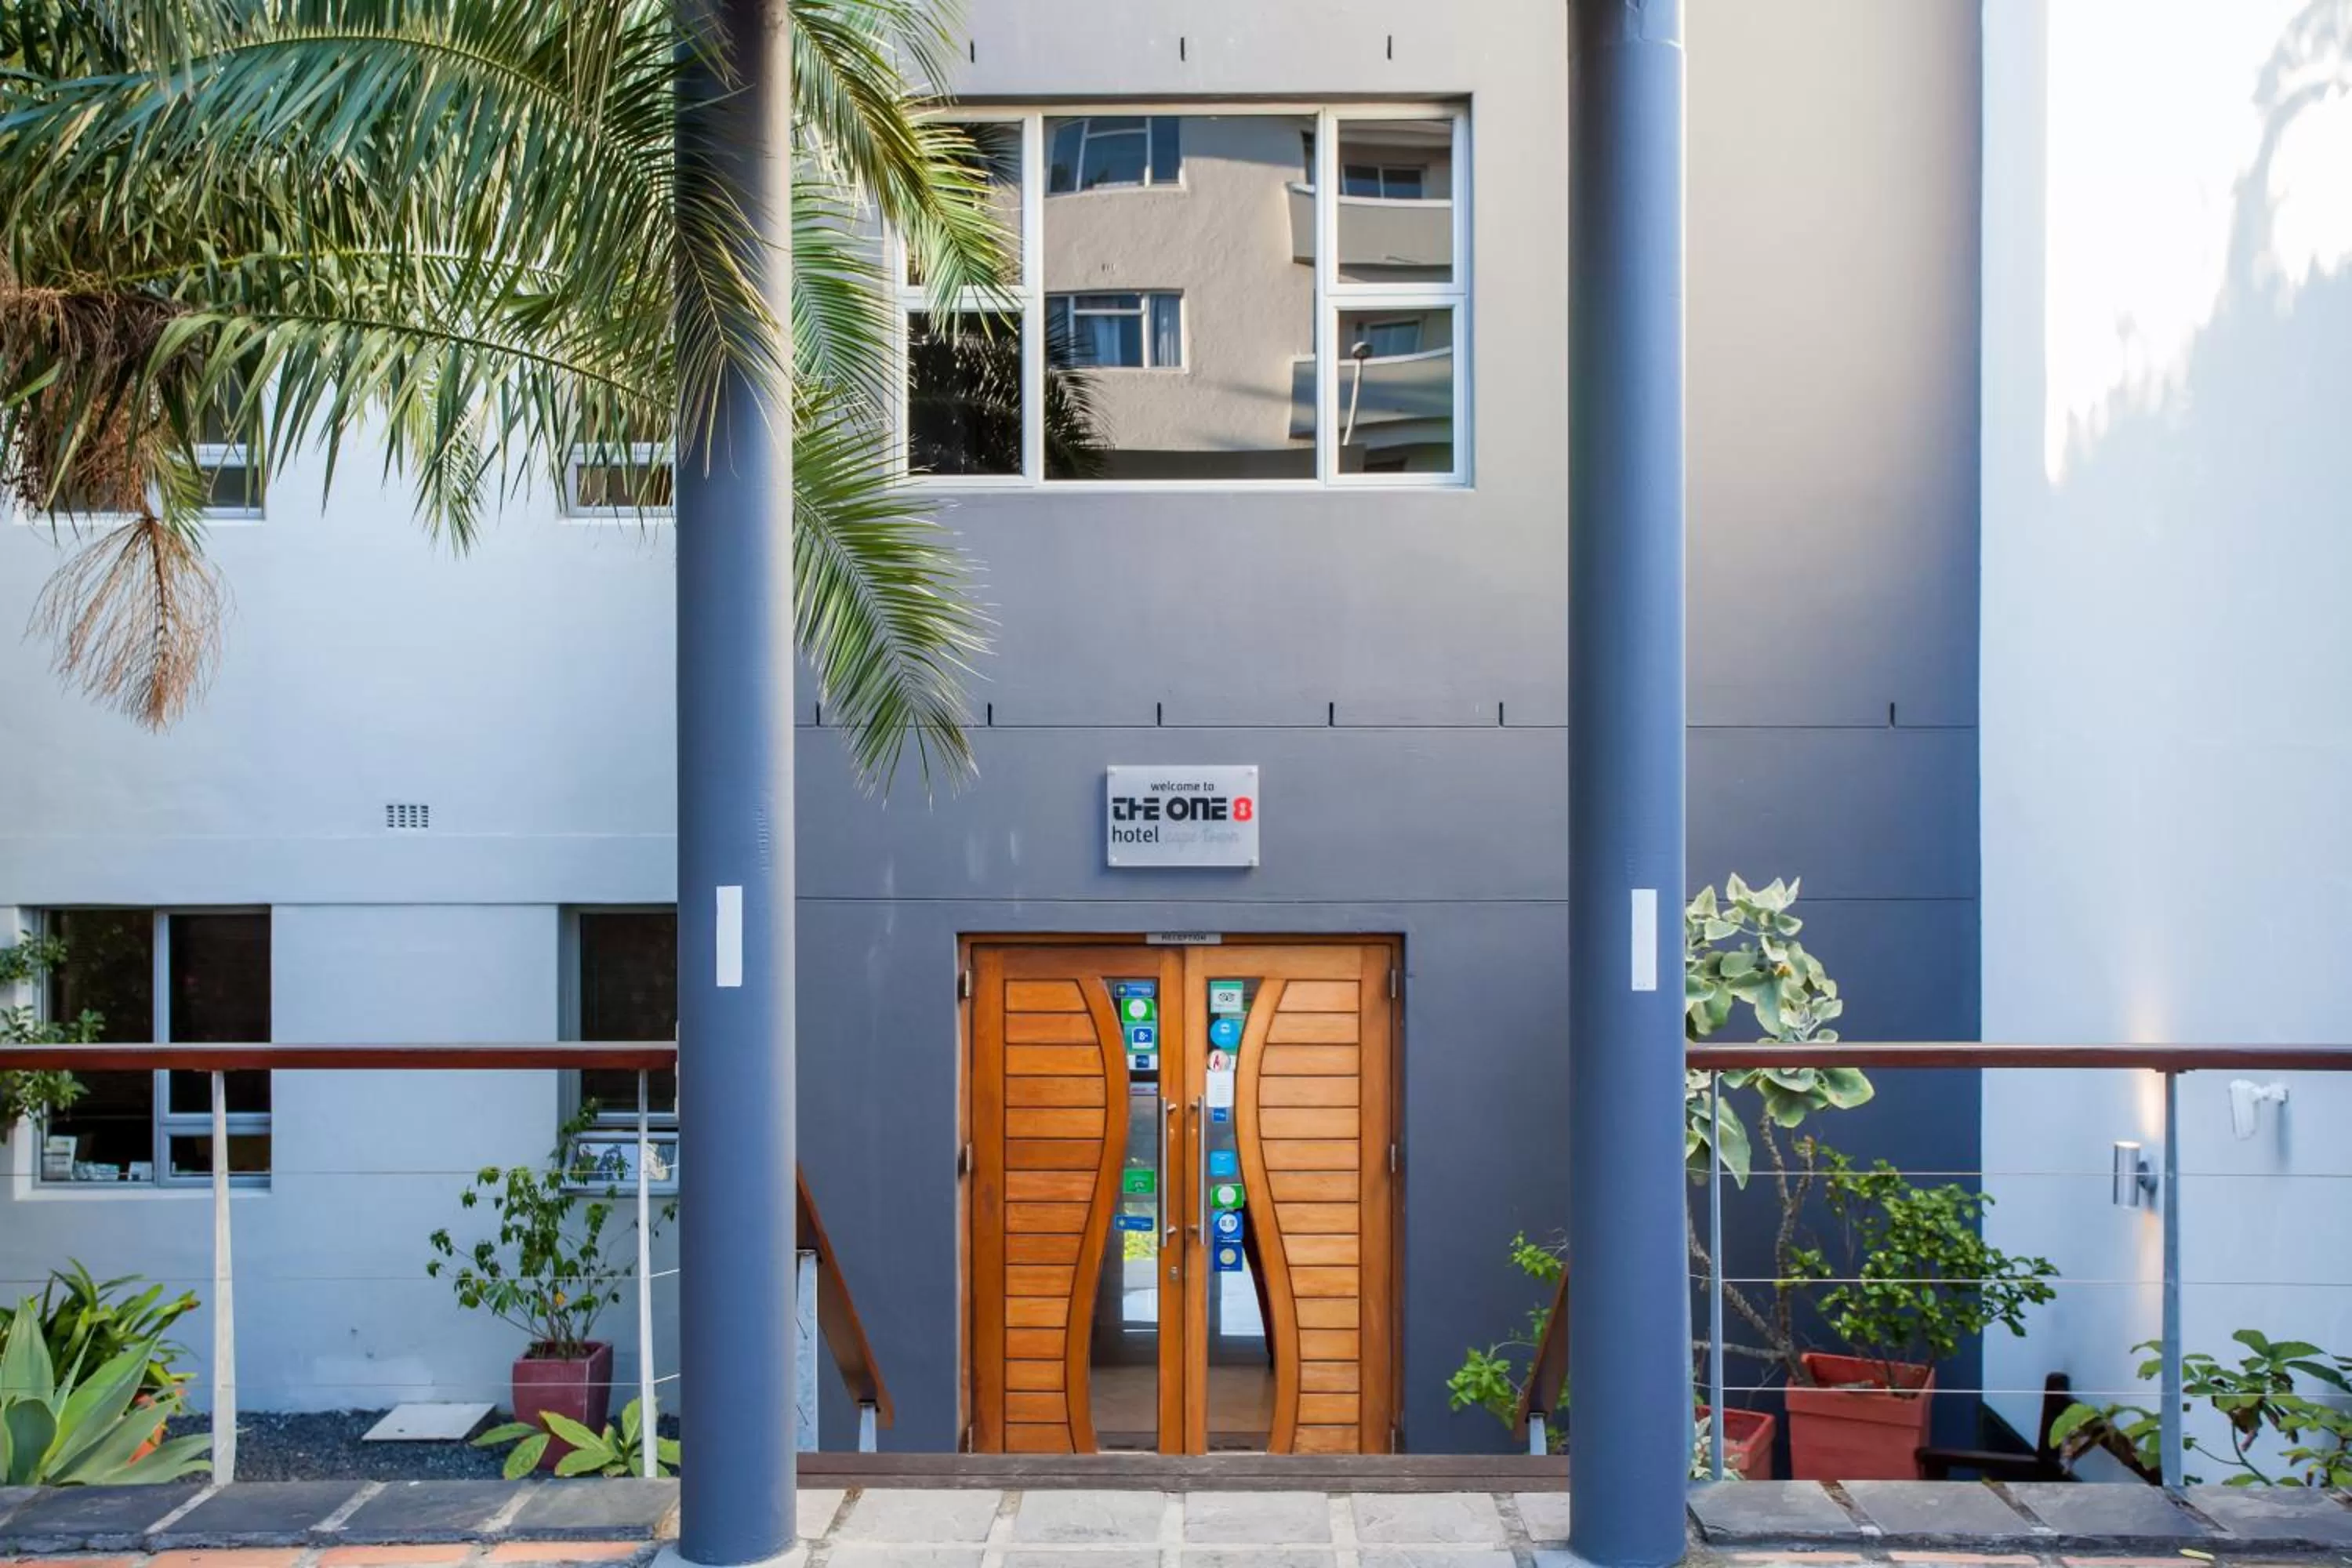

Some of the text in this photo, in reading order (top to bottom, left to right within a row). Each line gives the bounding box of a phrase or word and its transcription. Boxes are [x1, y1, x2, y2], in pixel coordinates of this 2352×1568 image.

[1150, 781, 1214, 791] welcome to
[1166, 797, 1227, 821] ONE
[1232, 796, 1253, 822] 8
[1112, 825, 1159, 843] hotel
